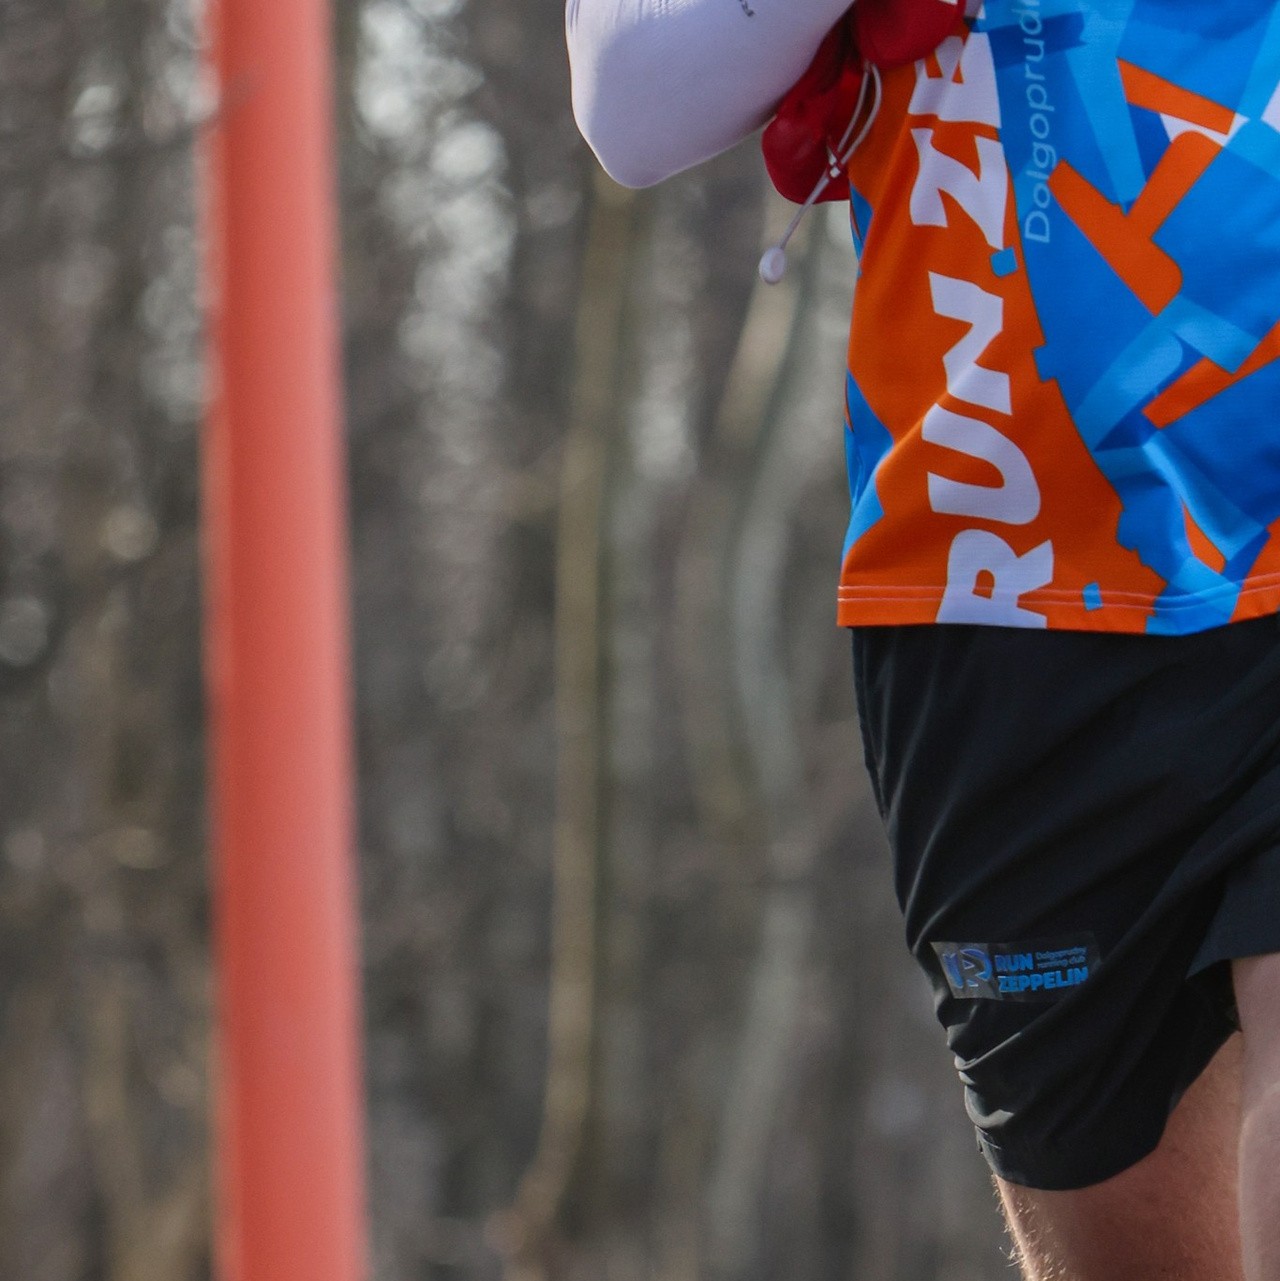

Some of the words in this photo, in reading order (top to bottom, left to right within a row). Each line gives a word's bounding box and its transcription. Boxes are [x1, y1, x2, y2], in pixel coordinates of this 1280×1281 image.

[920, 269, 1054, 628] RUN
[994, 952, 1034, 972] RUN
[997, 965, 1089, 993] ZEPPELIN
